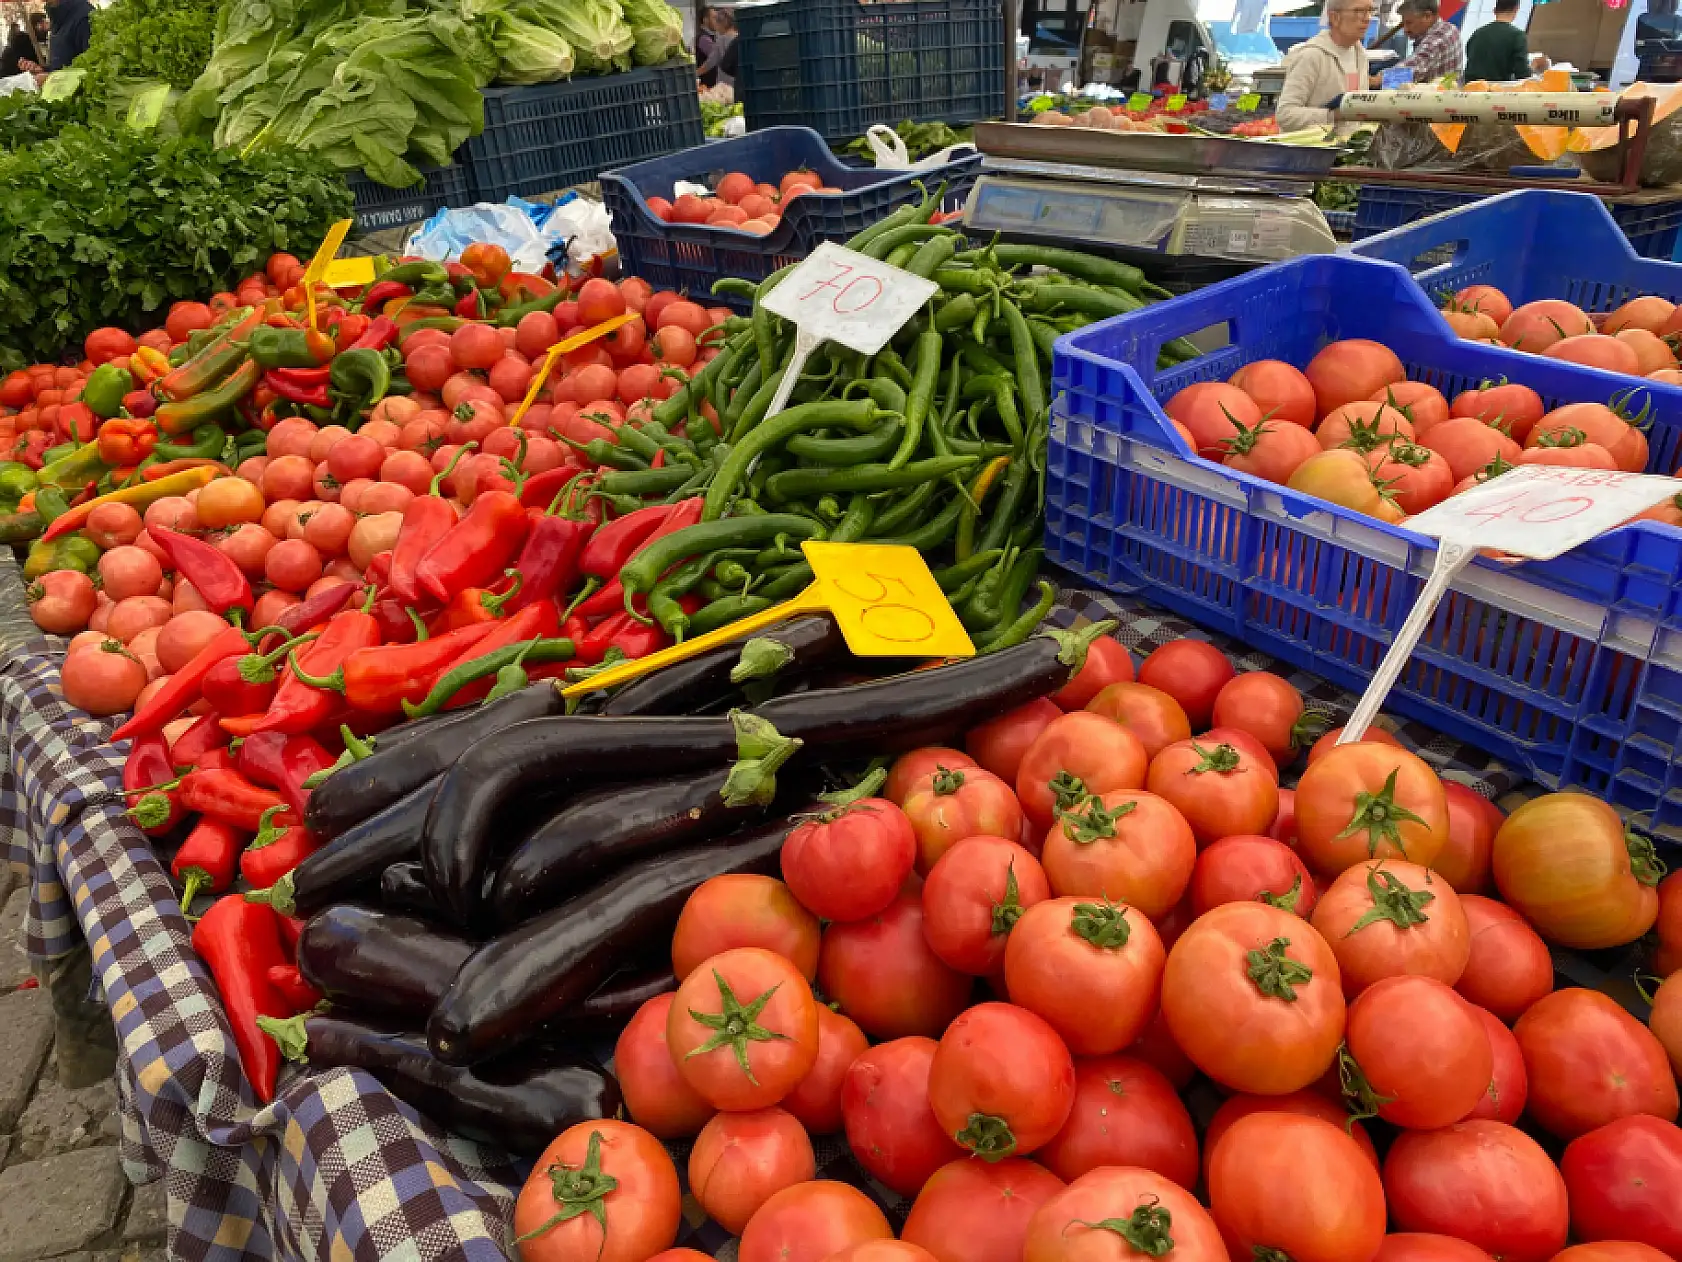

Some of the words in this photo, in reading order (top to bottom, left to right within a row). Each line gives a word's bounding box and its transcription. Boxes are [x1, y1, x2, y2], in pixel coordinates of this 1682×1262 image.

[1549, 109, 1580, 122] ilka
[799, 258, 883, 314] 70
[1464, 490, 1595, 527] 40
[832, 571, 936, 643] 50
